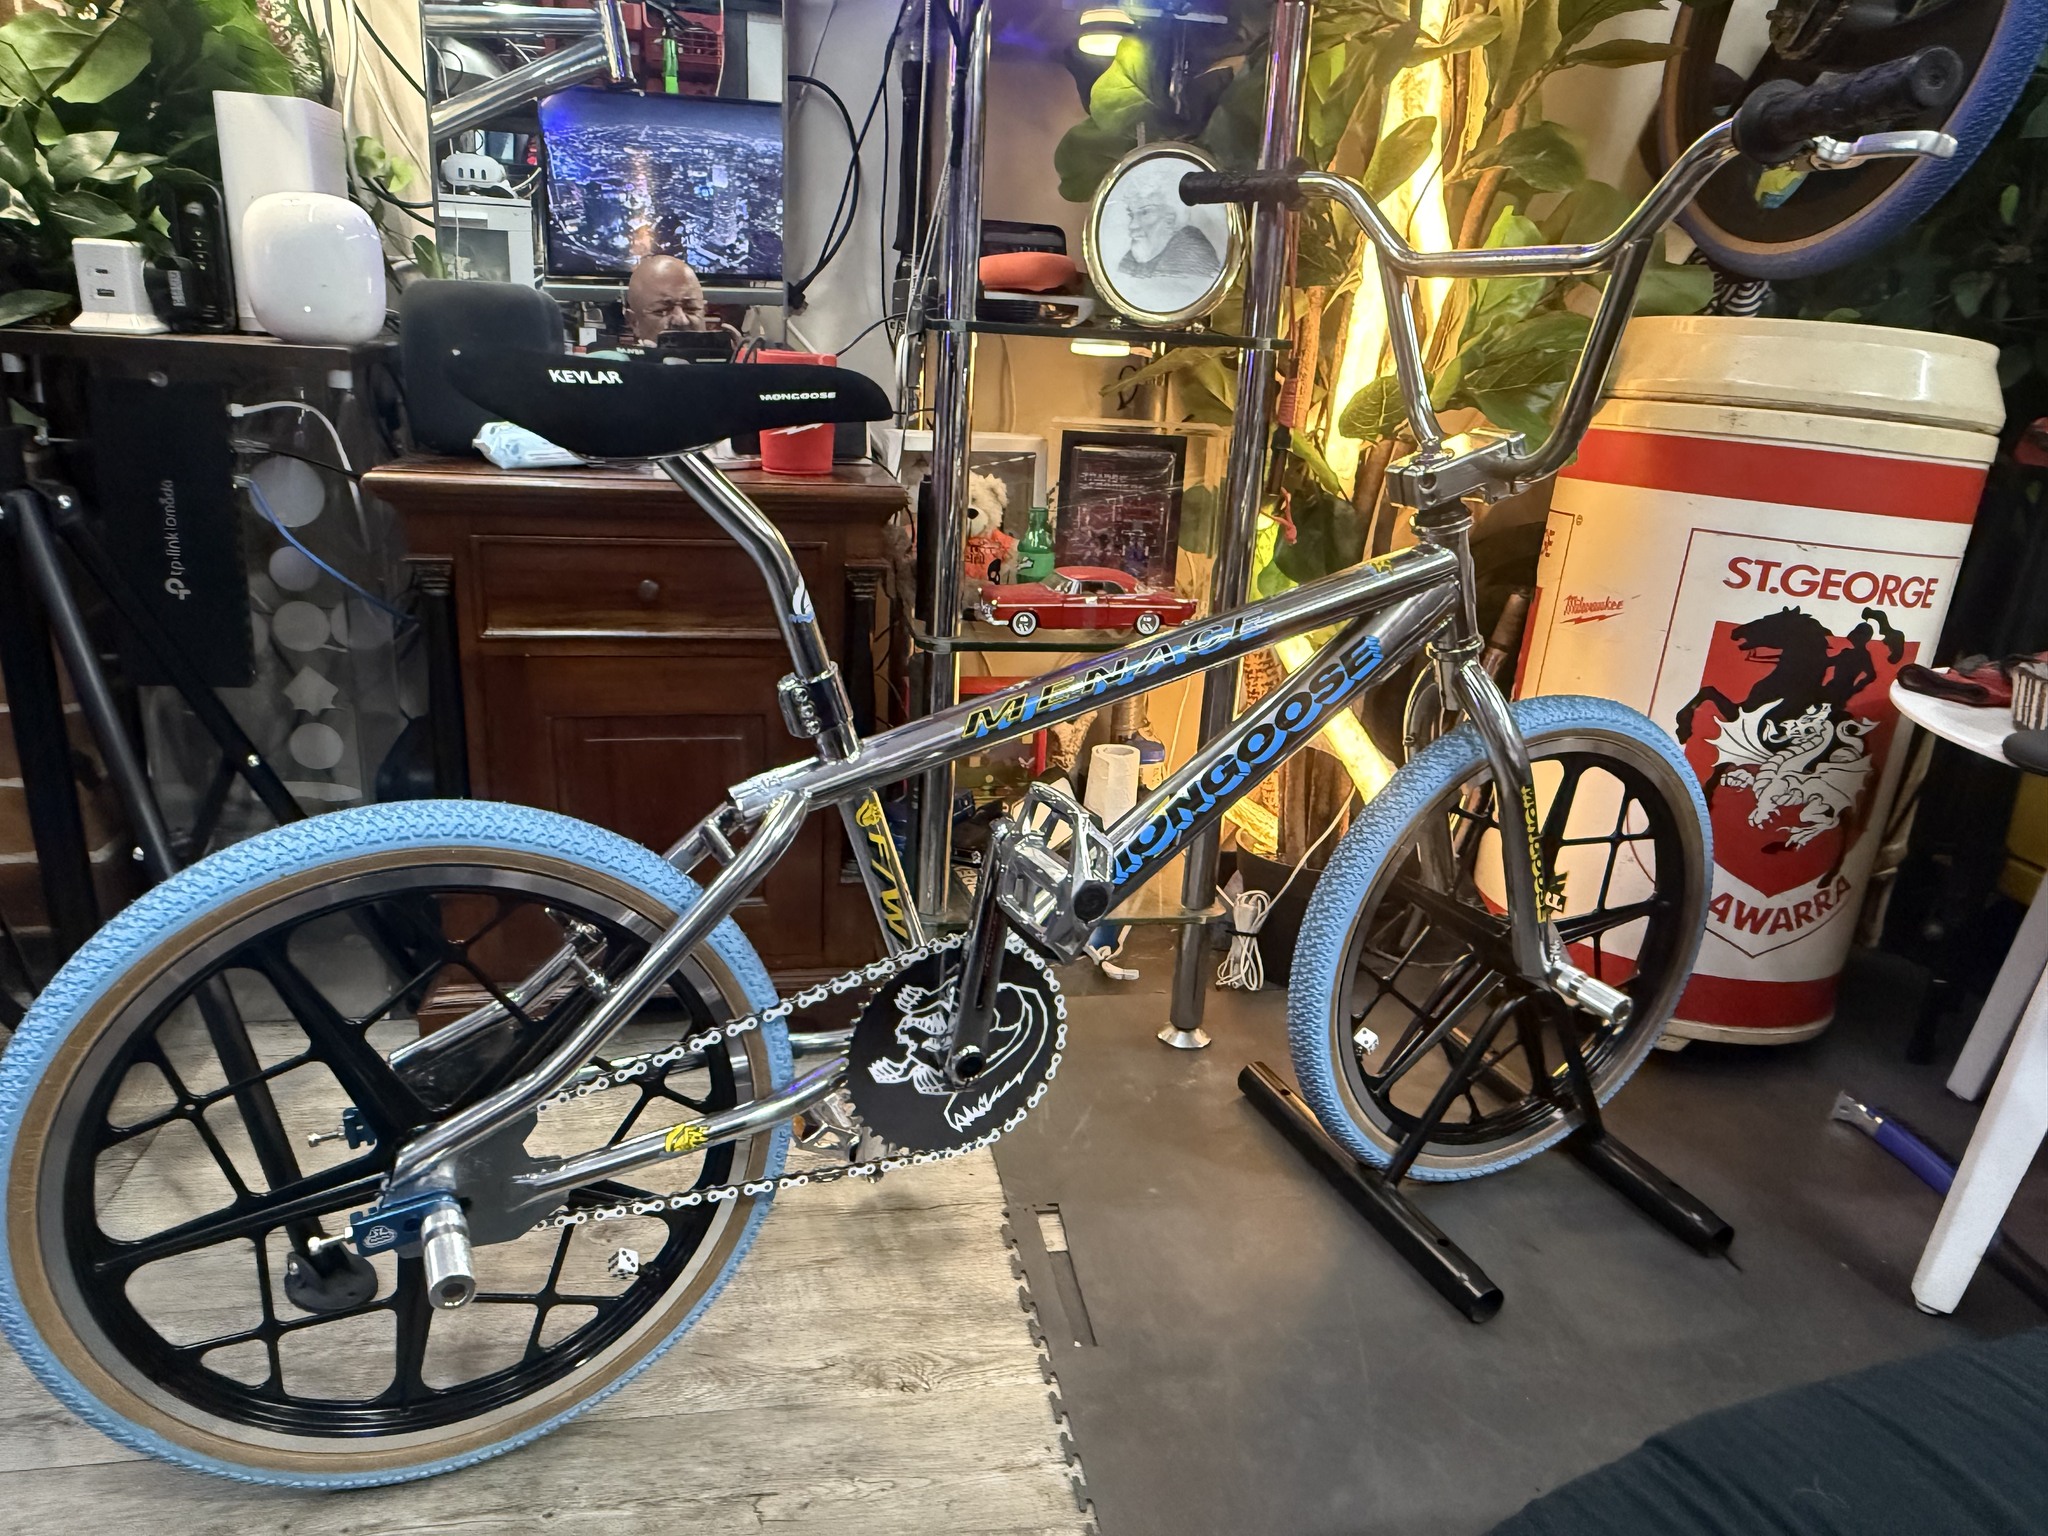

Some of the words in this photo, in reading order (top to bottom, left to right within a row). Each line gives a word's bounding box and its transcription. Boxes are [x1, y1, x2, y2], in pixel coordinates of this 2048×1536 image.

[548, 369, 624, 385] KEVLAR
[759, 391, 837, 401] MONGOOSE
[1722, 556, 1939, 609] ST.GEORGE
[1563, 594, 1624, 616] Milwaukee
[961, 607, 1273, 741] MENACE
[1708, 875, 1852, 936] AWARRA
